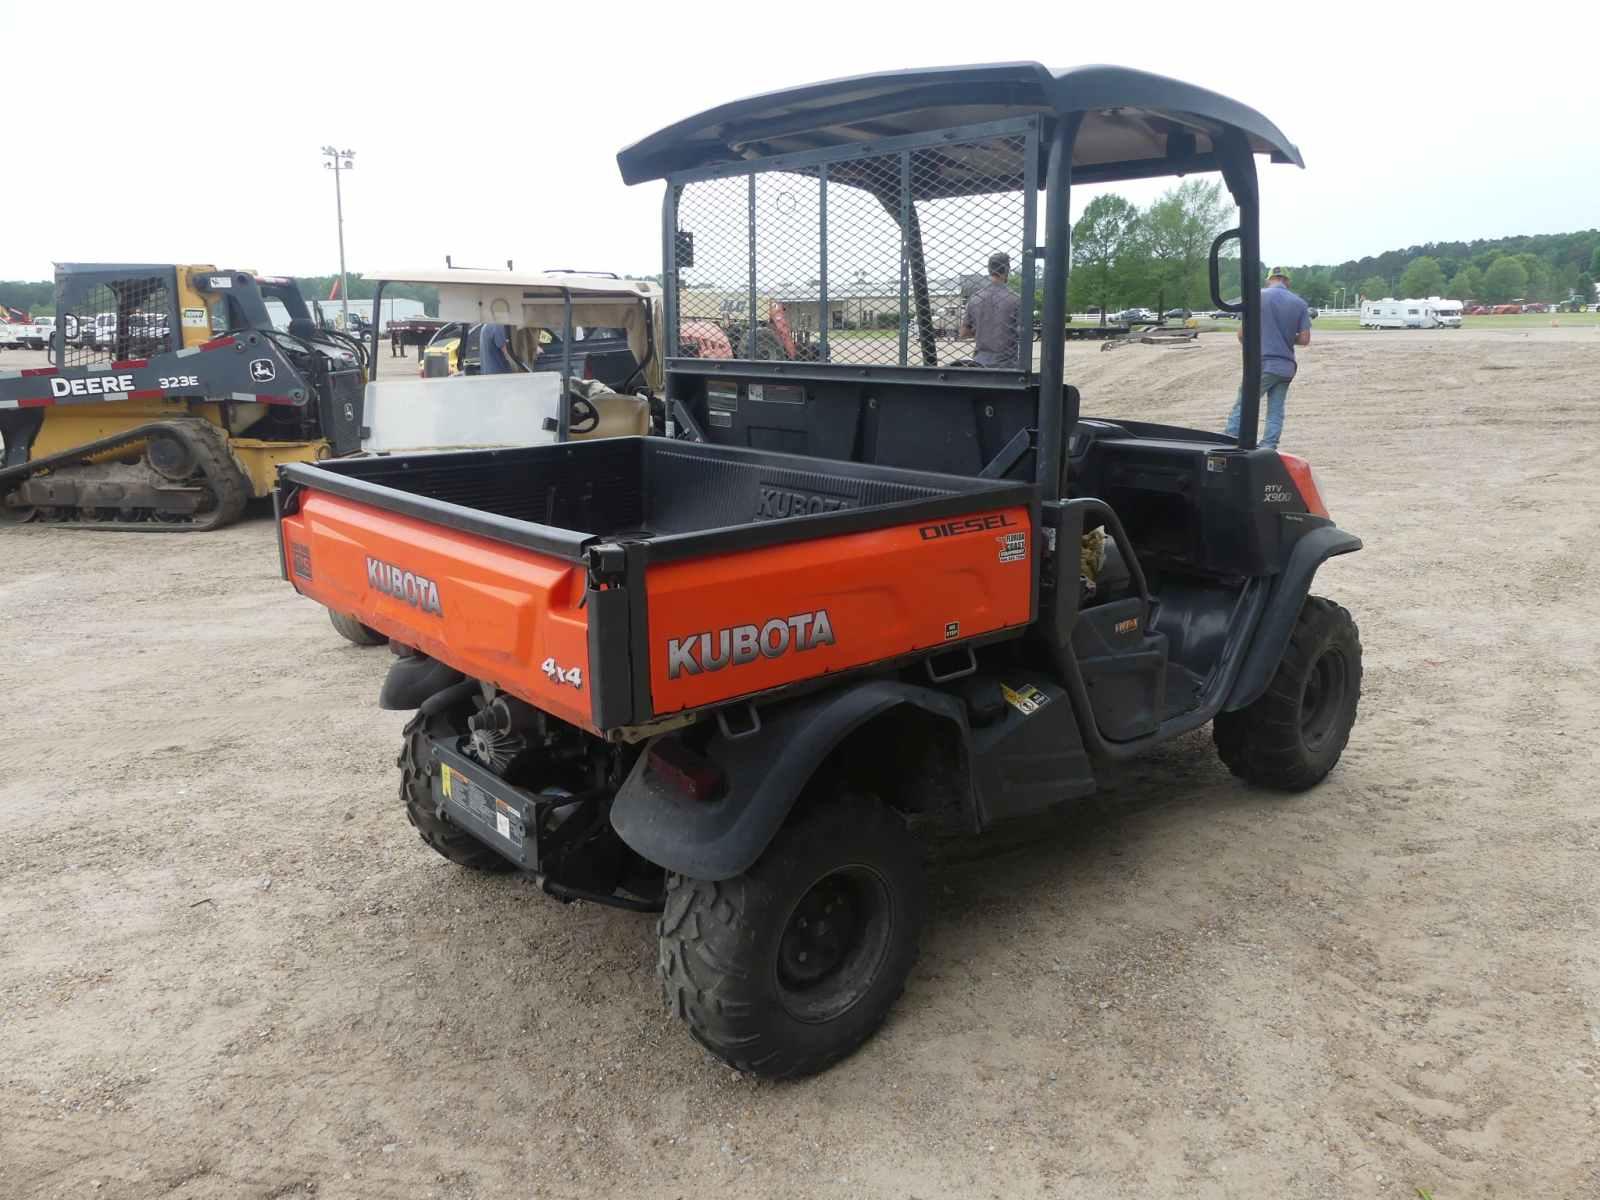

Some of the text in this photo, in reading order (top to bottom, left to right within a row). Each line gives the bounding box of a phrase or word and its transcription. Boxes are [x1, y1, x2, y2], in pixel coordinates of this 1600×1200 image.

[50, 374, 200, 398] DEERE 323E
[1264, 484, 1282, 493] RTV
[919, 514, 1017, 541] DIESEL
[366, 556, 443, 618] KUBOTA
[668, 608, 836, 681] KUBOTA
[541, 657, 583, 690] 4x4
